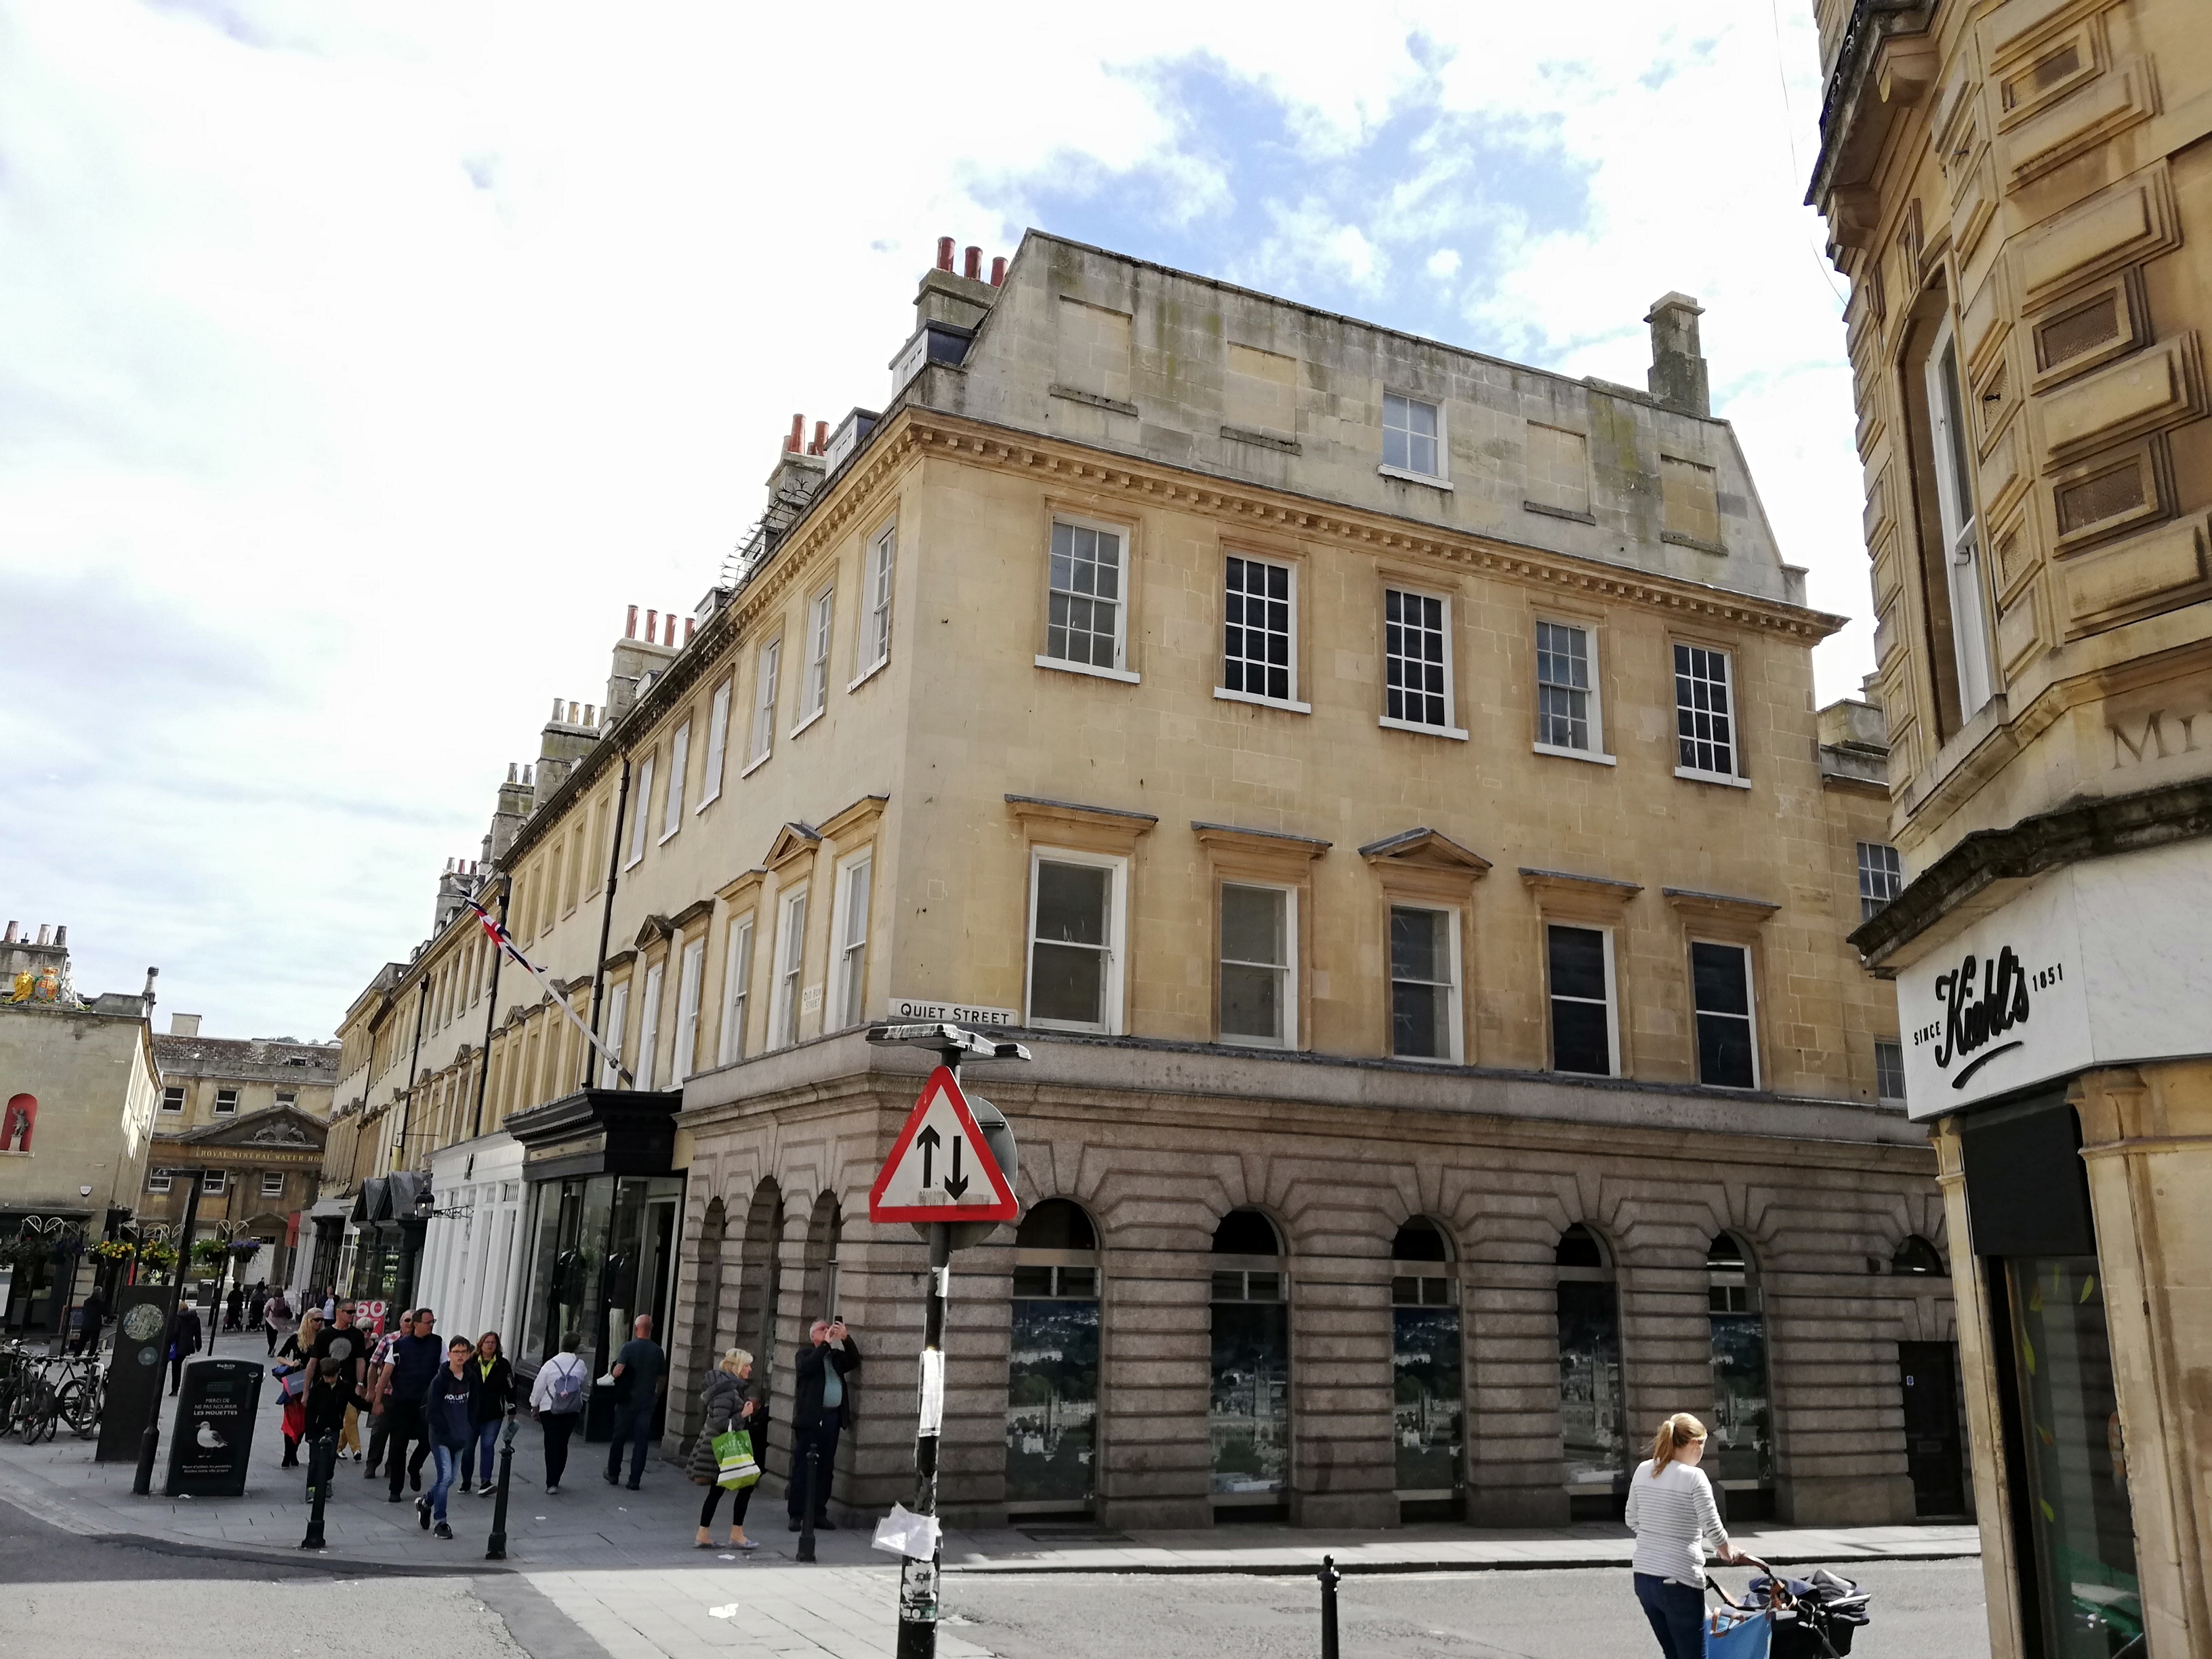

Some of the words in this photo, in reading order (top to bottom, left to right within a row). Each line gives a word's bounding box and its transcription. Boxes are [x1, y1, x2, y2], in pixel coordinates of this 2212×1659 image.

[2104, 709, 2212, 771] MI
[803, 990, 812, 1002] OLD
[805, 997, 821, 1010] STREET
[1914, 1021, 1941, 1046] SINCE
[2032, 963, 2063, 993] 1851
[1934, 945, 2029, 1068] Kiehl's
[901, 1003, 945, 1019] QUIET
[952, 1008, 1010, 1024] STREET
[232, 1151, 271, 1160] MINERAL
